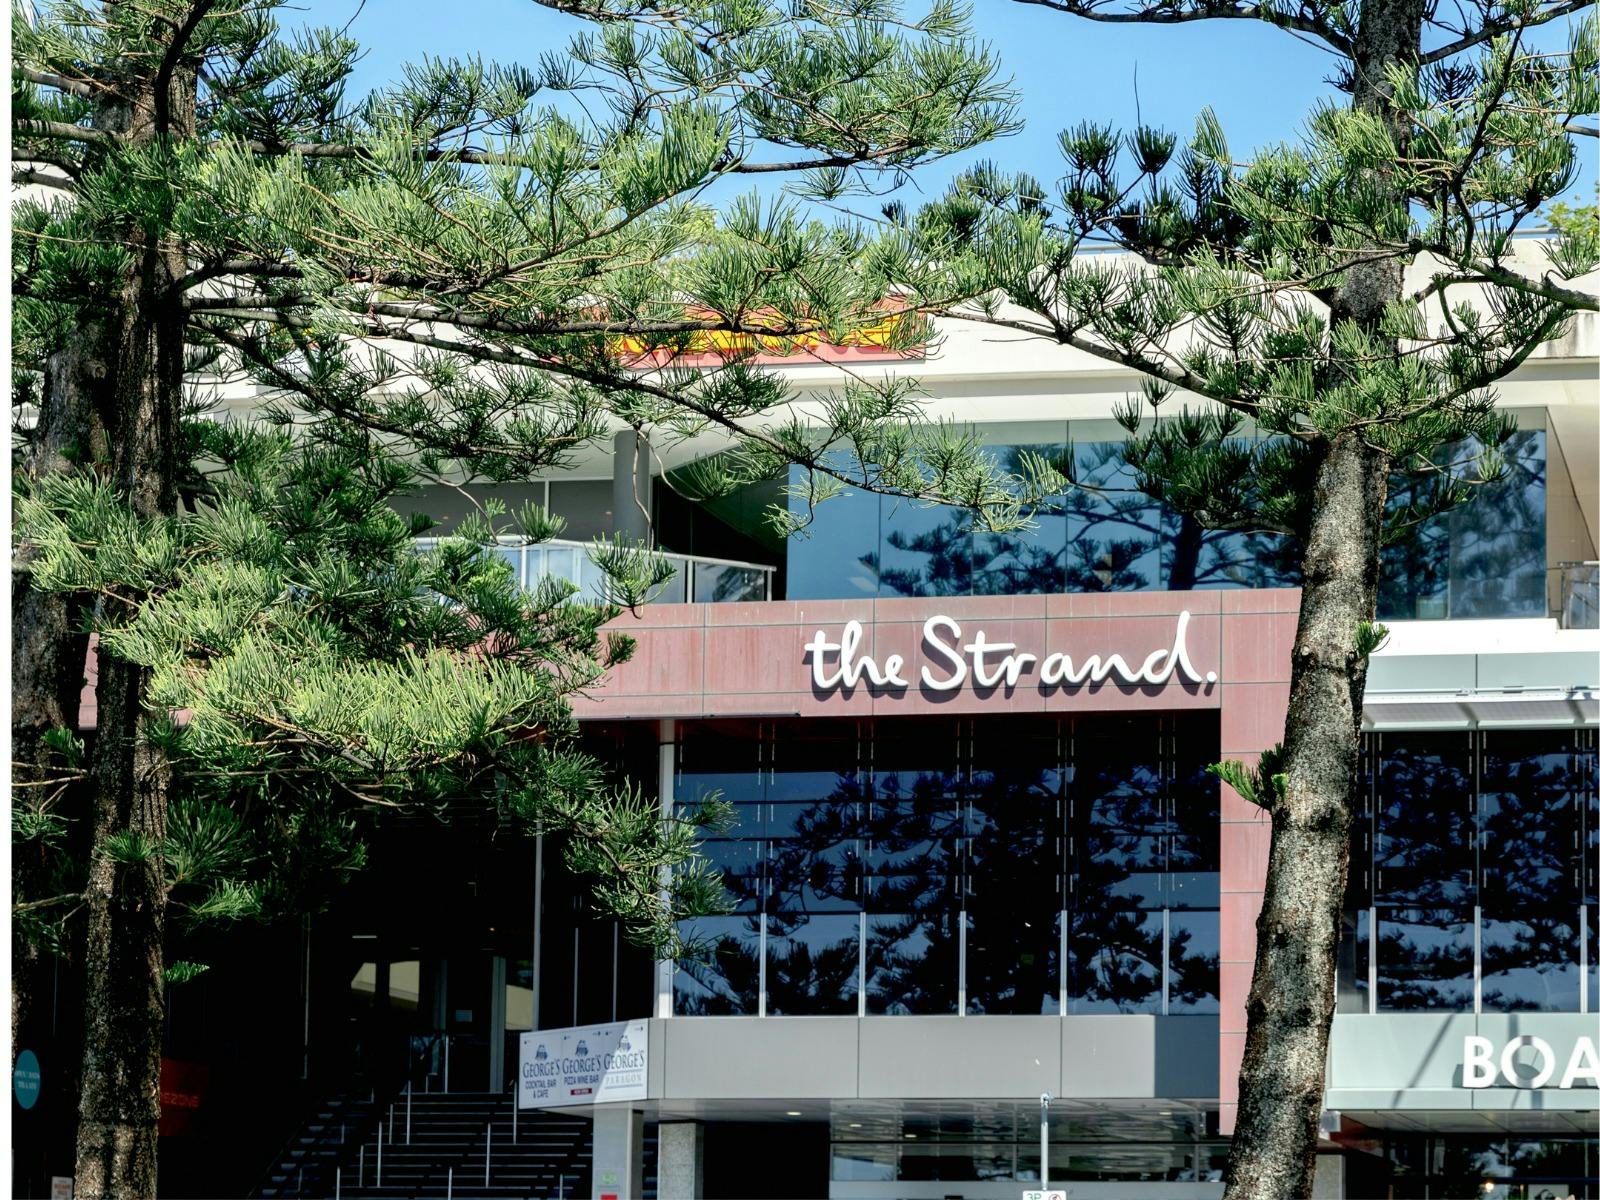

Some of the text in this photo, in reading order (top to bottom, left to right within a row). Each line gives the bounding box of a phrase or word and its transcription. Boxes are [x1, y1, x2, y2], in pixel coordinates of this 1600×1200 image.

[804, 619, 909, 689] the
[1462, 1035, 1599, 1089] BOA
[525, 1079, 556, 1090] COCKTAIL BAR
[564, 1076, 576, 1086] PIZZA
[589, 1074, 599, 1084] BAR
[160, 1091, 200, 1109] EZONE
